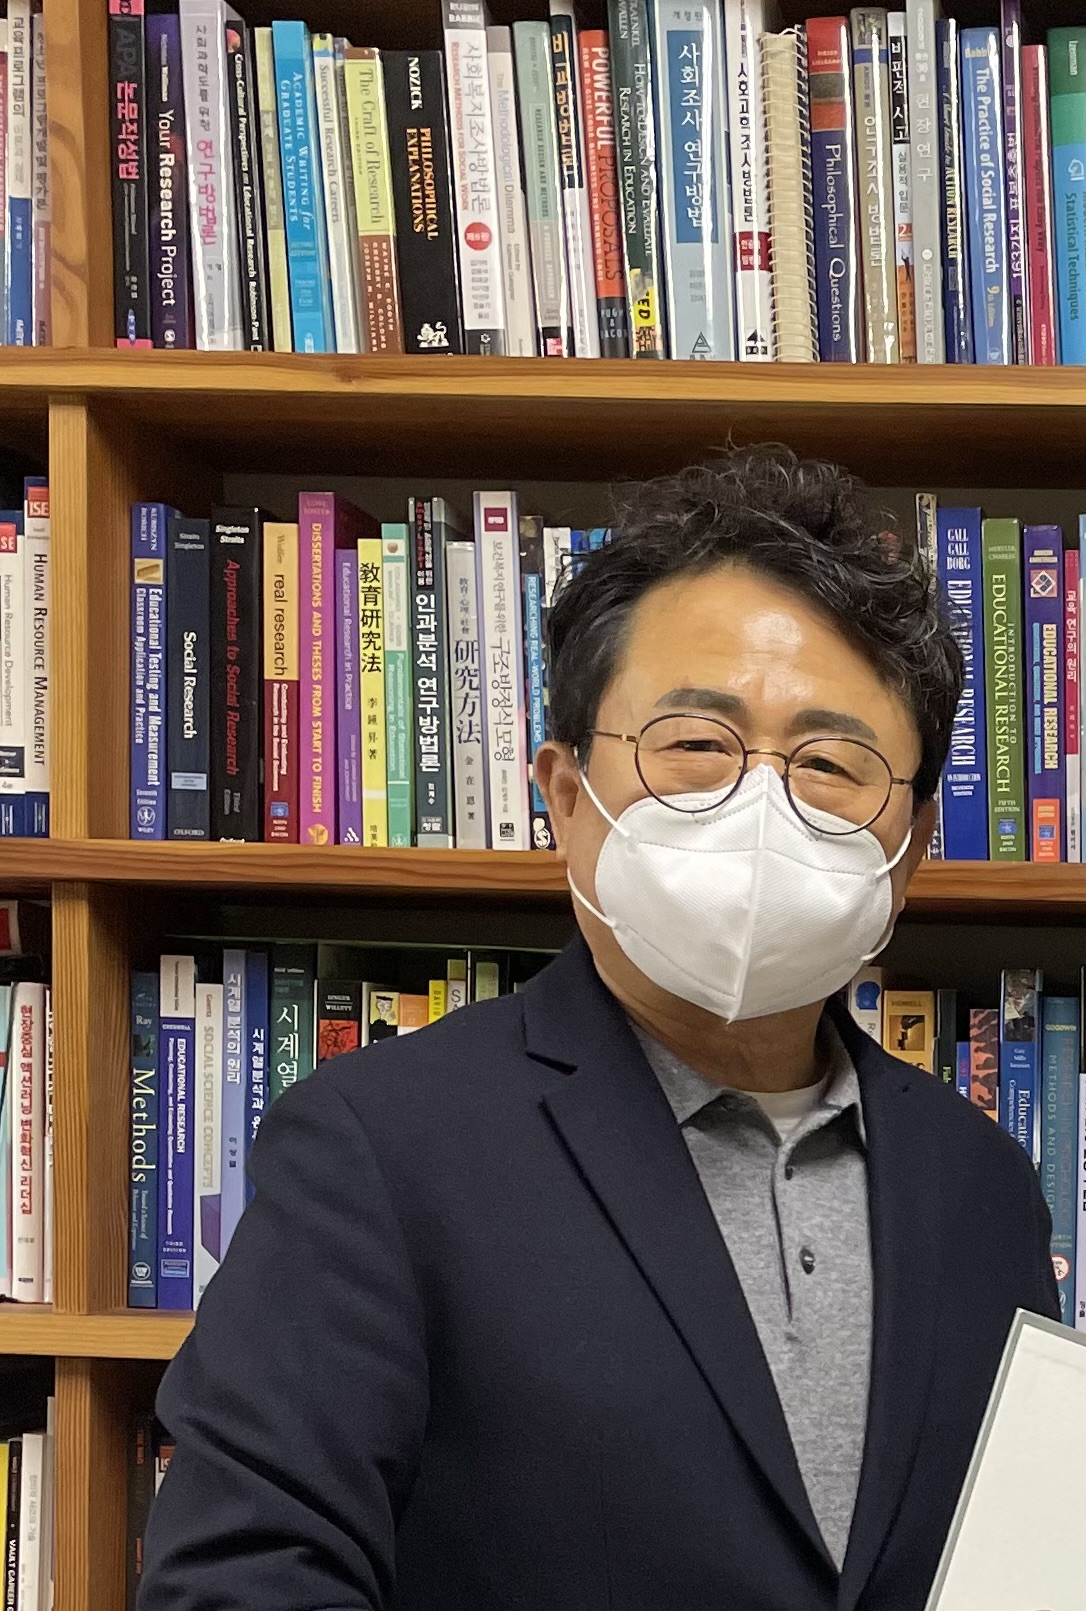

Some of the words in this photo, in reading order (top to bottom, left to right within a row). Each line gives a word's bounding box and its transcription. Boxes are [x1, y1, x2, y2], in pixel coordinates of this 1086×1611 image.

[234, 53, 246, 116] Cross-Cultural
[293, 72, 306, 139] ACADEMIC
[359, 69, 374, 92] The
[407, 57, 422, 110] NOZICK
[590, 46, 615, 151] POWERFUL
[678, 44, 703, 127] 사회조사
[116, 81, 139, 179] 논문작성법
[158, 109, 175, 150] Your
[237, 118, 248, 172] Perspectives
[360, 96, 377, 138] Craft
[368, 142, 378, 155] of
[463, 42, 492, 214] 사회복지조사방법론
[159, 153, 177, 242] Research
[285, 155, 298, 222] STUDENTS
[298, 146, 311, 202] WRITING
[366, 158, 384, 224] Research
[405, 128, 424, 234] EXPLANATIONS
[420, 128, 439, 241] PHILOSOPHICAL
[824, 144, 845, 250] Philosophical
[243, 186, 254, 237] Educational
[301, 206, 311, 230] for
[599, 155, 625, 281] PROPOSALS
[156, 246, 176, 306] Project
[247, 238, 256, 278] Research
[827, 258, 845, 343] Questions
[33, 554, 48, 601] HUMAN
[274, 573, 285, 603] real
[312, 523, 322, 608] DISSERTATIONS
[226, 559, 240, 641] Approaches
[312, 612, 322, 637] AND
[34, 607, 48, 672] RESOURCE
[183, 631, 197, 674] Social
[227, 646, 239, 660] to
[273, 608, 285, 676] research
[312, 641, 322, 677] THESES
[416, 594, 438, 672] 인과분석
[992, 574, 1008, 700] EDUCATIONAL
[1042, 623, 1058, 705] EDUCATIONAL
[183, 677, 198, 739] Research
[226, 663, 240, 709] Social
[312, 680, 322, 713] FROM
[454, 640, 481, 745] 研究方法
[32, 677, 48, 765] MANAGEMENT
[226, 712, 240, 776] Research
[312, 715, 322, 751] START
[417, 677, 441, 772] 연구방법론
[995, 705, 1011, 792] RESEARCH
[1044, 709, 1059, 769] RESEARCH
[312, 753, 322, 772] TO
[312, 776, 322, 813] FINISH
[131, 1069, 156, 1182] Methods
